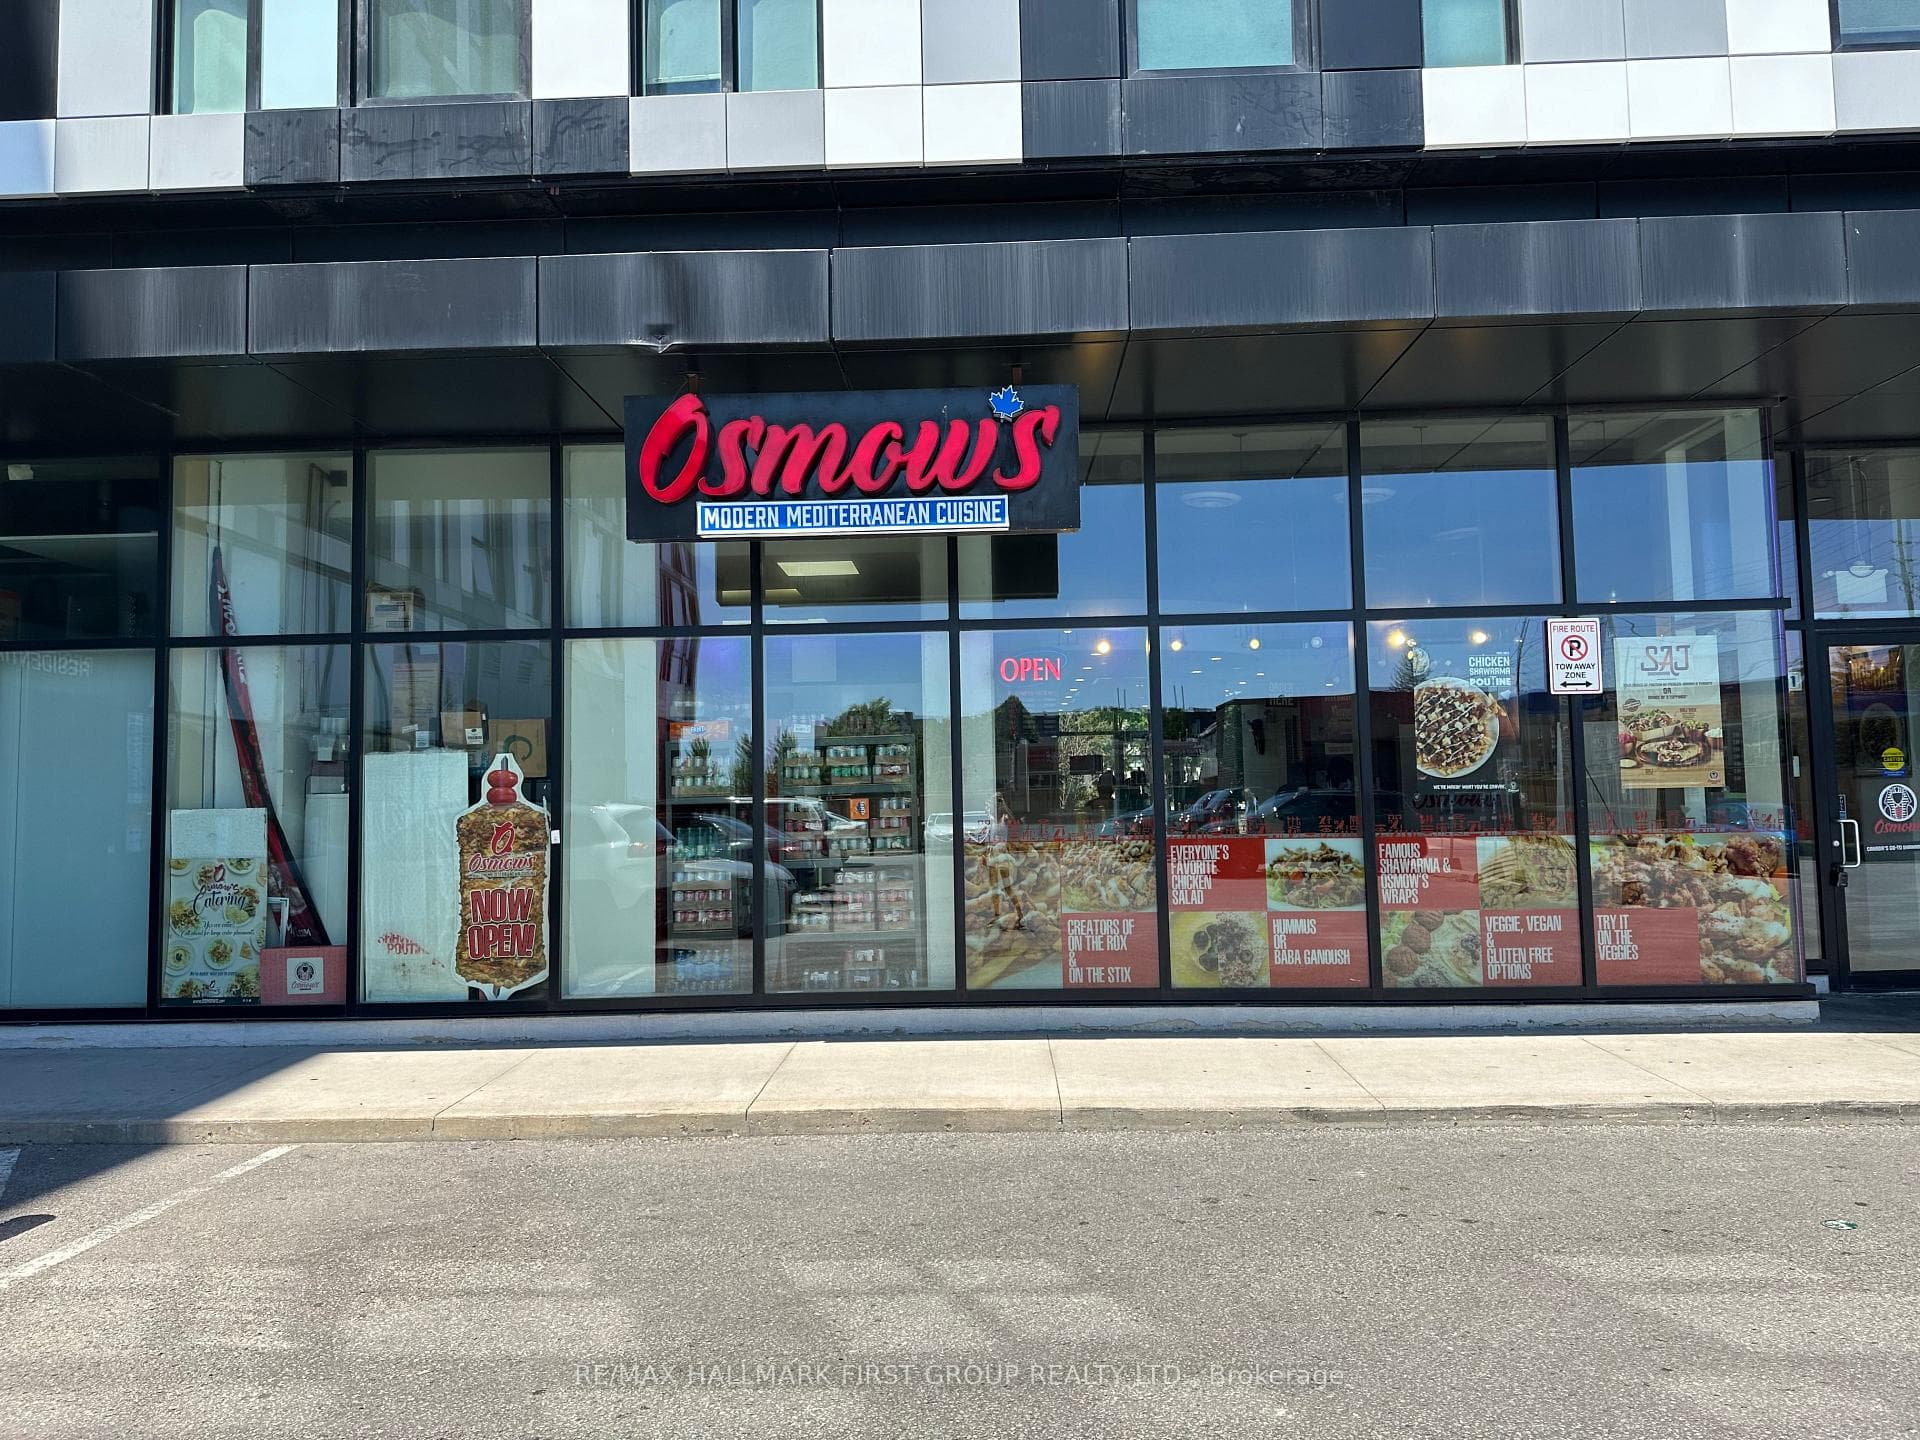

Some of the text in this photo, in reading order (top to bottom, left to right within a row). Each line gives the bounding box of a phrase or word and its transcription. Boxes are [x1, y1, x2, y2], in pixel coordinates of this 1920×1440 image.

[703, 499, 1003, 530] MODERN MEDITERRANEAN CUISINE
[1552, 624, 1596, 633] FIRE ROUTE
[1468, 655, 1510, 667] CHICKEN
[1555, 662, 1596, 671] TOW AWAY
[1640, 644, 1691, 676] SAJ
[999, 656, 1061, 682] OPEN
[1469, 667, 1511, 676] SHAWARMA
[1564, 671, 1587, 679] ZONE
[1469, 676, 1511, 686] POUTINE
[1789, 675, 1796, 688] 1
[1170, 844, 1229, 861] EVERYONE'S
[1378, 843, 1421, 859] FAMOUS
[1170, 859, 1217, 875] FAVORITE
[1379, 858, 1451, 874] SHAWARMA &
[1171, 874, 1212, 890] CHICKEN
[1380, 873, 1429, 889] OSMOW'S
[193, 891, 246, 916] Catering
[1172, 889, 1204, 905] SALAD
[1381, 888, 1419, 904] WRAPS
[470, 888, 535, 923] NOW
[1067, 919, 1135, 936] CREATORS OF
[1272, 918, 1316, 935] HUMMUS
[1485, 915, 1562, 934] VEGGIE, VEGAN
[1596, 914, 1630, 930] TRY IT
[468, 923, 537, 960] OPEN!
[1068, 935, 1128, 952] ON THE ROX
[1273, 934, 1287, 950] OR
[1486, 932, 1494, 948] &
[1597, 929, 1633, 946] ON THE
[1068, 952, 1077, 967] &
[1274, 949, 1351, 965] BABA GANOUSH
[1486, 947, 1553, 964] GLUTEN FREE
[1598, 944, 1639, 961] VEGGIES
[1069, 966, 1132, 984] ON THE STIX
[1487, 963, 1532, 980] OPTIONS
